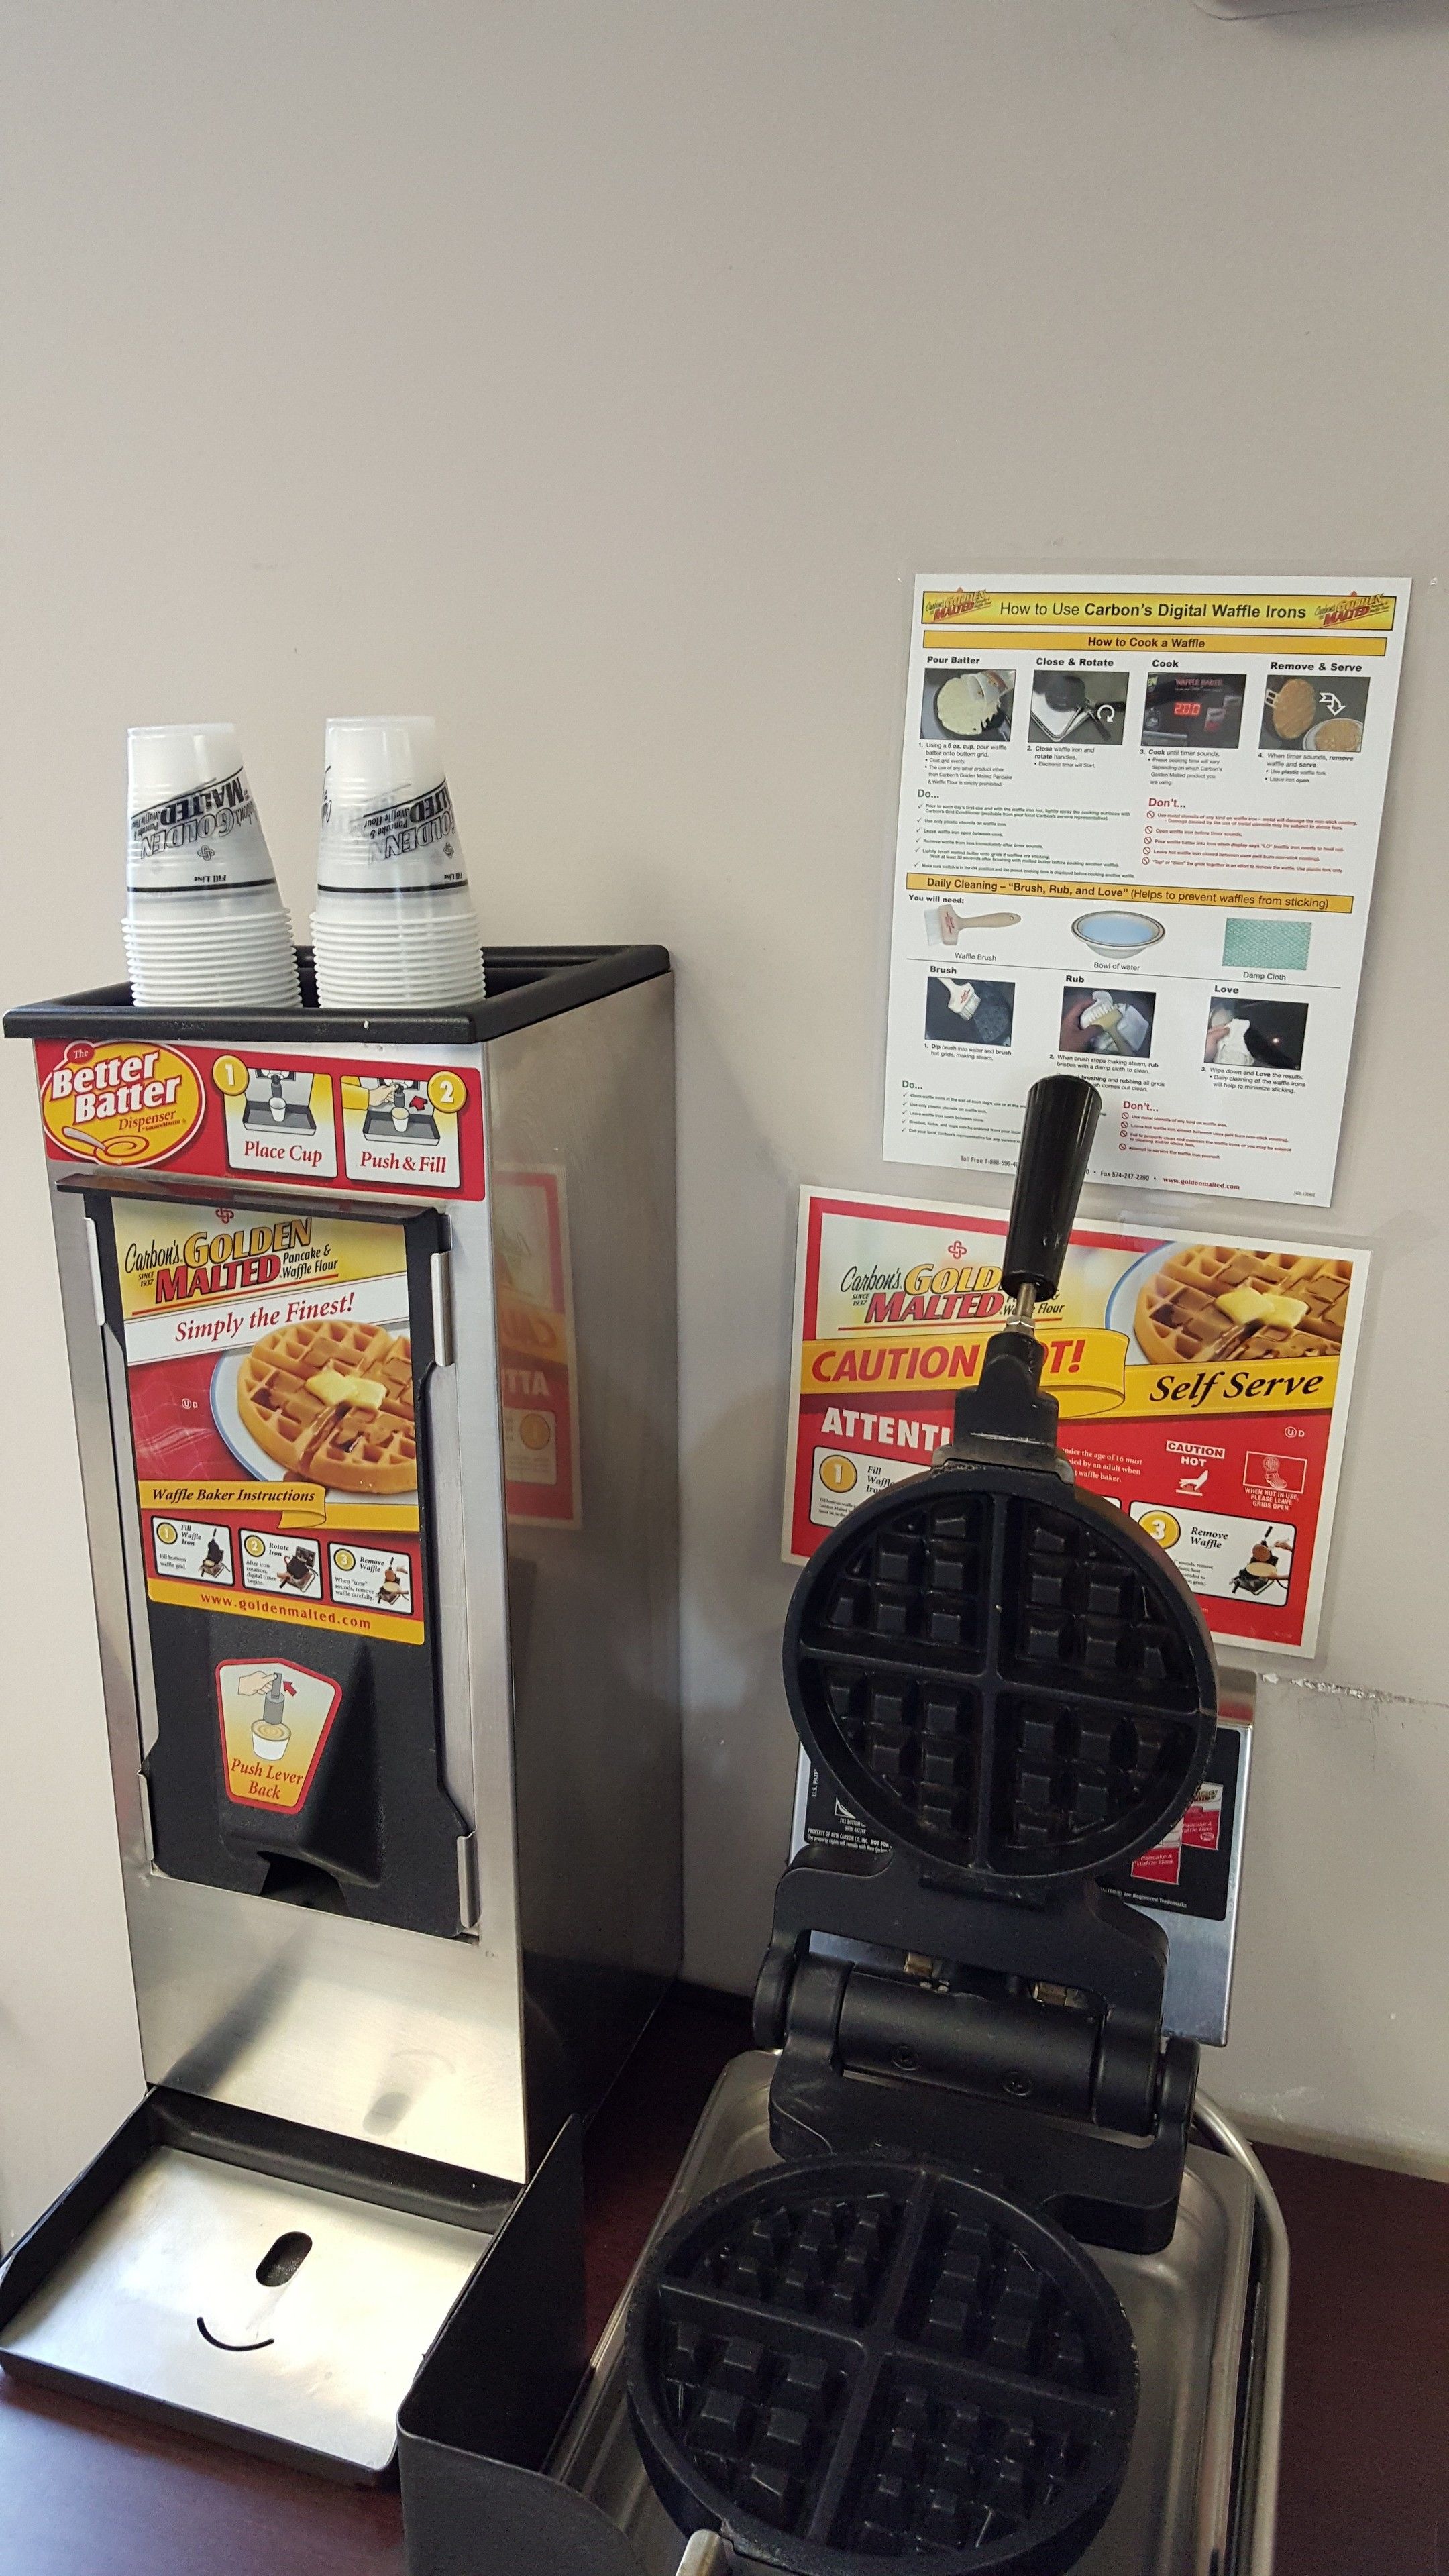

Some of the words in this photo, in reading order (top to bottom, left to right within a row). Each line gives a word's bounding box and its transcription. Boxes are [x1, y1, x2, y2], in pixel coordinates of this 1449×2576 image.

[1000, 603, 1030, 614] How
[1036, 604, 1048, 615] to
[1053, 604, 1079, 615] Use
[1158, 604, 1207, 619] Digital
[1212, 605, 1260, 617] Waffle
[1266, 605, 1306, 619] Irons
[1088, 637, 1112, 646] How
[1116, 638, 1126, 647] to
[1130, 638, 1157, 647] Cook
[1172, 639, 1205, 647] Waffle
[951, 657, 979, 665] Batter
[1036, 658, 1064, 666] Close
[1068, 658, 1075, 666] &
[1079, 659, 1114, 667] Rotate
[1271, 662, 1314, 670] Remove
[1331, 663, 1362, 672] Serve
[160, 777, 244, 826] MALTED
[141, 808, 234, 859] GOLDEN
[927, 878, 951, 888] Daily
[954, 880, 997, 892] Cleaning
[1049, 885, 1072, 895] Rub,
[1131, 890, 1162, 900] (Helps
[1179, 893, 1216, 902] prevent
[1220, 894, 1254, 904] waffles
[1258, 896, 1281, 905] from
[1285, 897, 1329, 910] sticking)
[930, 966, 957, 974] Brush
[1214, 985, 1239, 994] Love
[73, 1050, 88, 1059] The
[50, 1050, 160, 1102] Better
[225, 1064, 235, 1085] 1
[441, 1081, 455, 1103] 2
[73, 1075, 182, 1125] Batter
[119, 1110, 176, 1132] Dispenser
[244, 1141, 285, 1159] Place
[290, 1145, 323, 1167] Cup
[360, 1151, 400, 1170] Push
[402, 1157, 416, 1170] &
[419, 1156, 447, 1173] Fill
[1163, 1177, 1240, 1190] www.goldenmalted.com
[183, 1216, 313, 1269] GOLDEN
[139, 1272, 154, 1280] SINCE
[155, 1254, 281, 1304] MALTED
[283, 1248, 320, 1265] Pancake
[323, 1244, 331, 1256] &
[282, 1264, 312, 1279] Waffle
[315, 1260, 338, 1272] Flour
[140, 1279, 154, 1287] 1937
[904, 1263, 1003, 1295] GOLD
[865, 1291, 1004, 1323] MALTED
[1038, 1303, 1065, 1314] Flour
[175, 1311, 245, 1342] Simply
[250, 1307, 279, 1327] the
[284, 1292, 356, 1322] Finest!
[812, 1344, 981, 1383] CAUTION
[1149, 1371, 1225, 1407] Self
[1224, 1371, 1324, 1398] Serve
[1168, 1442, 1224, 1457] CAUTION
[1083, 1460, 1091, 1468] by
[1122, 1467, 1140, 1475] when
[1181, 1456, 1206, 1467] HOT
[867, 1466, 881, 1475] Fill
[1101, 1473, 1121, 1482] baker.
[152, 1488, 193, 1503] Waffle
[197, 1489, 234, 1501] Baker
[237, 1489, 315, 1502] Instructions
[1244, 1487, 1263, 1495] WHEN
[1265, 1489, 1276, 1497] NOT
[1274, 1497, 1292, 1505] LEAVE
[182, 1532, 201, 1541] Waffle
[1191, 1527, 1228, 1540] Remove
[269, 1543, 289, 1551] Rotate
[1191, 1537, 1222, 1549] Waffle
[360, 1556, 384, 1566] Remove
[360, 1564, 380, 1572] Waffle
[201, 1592, 371, 1629] www.goldenmalted.com
[231, 1758, 262, 1777] Push
[266, 1765, 303, 1784] Lever
[248, 1780, 280, 1799] Back
